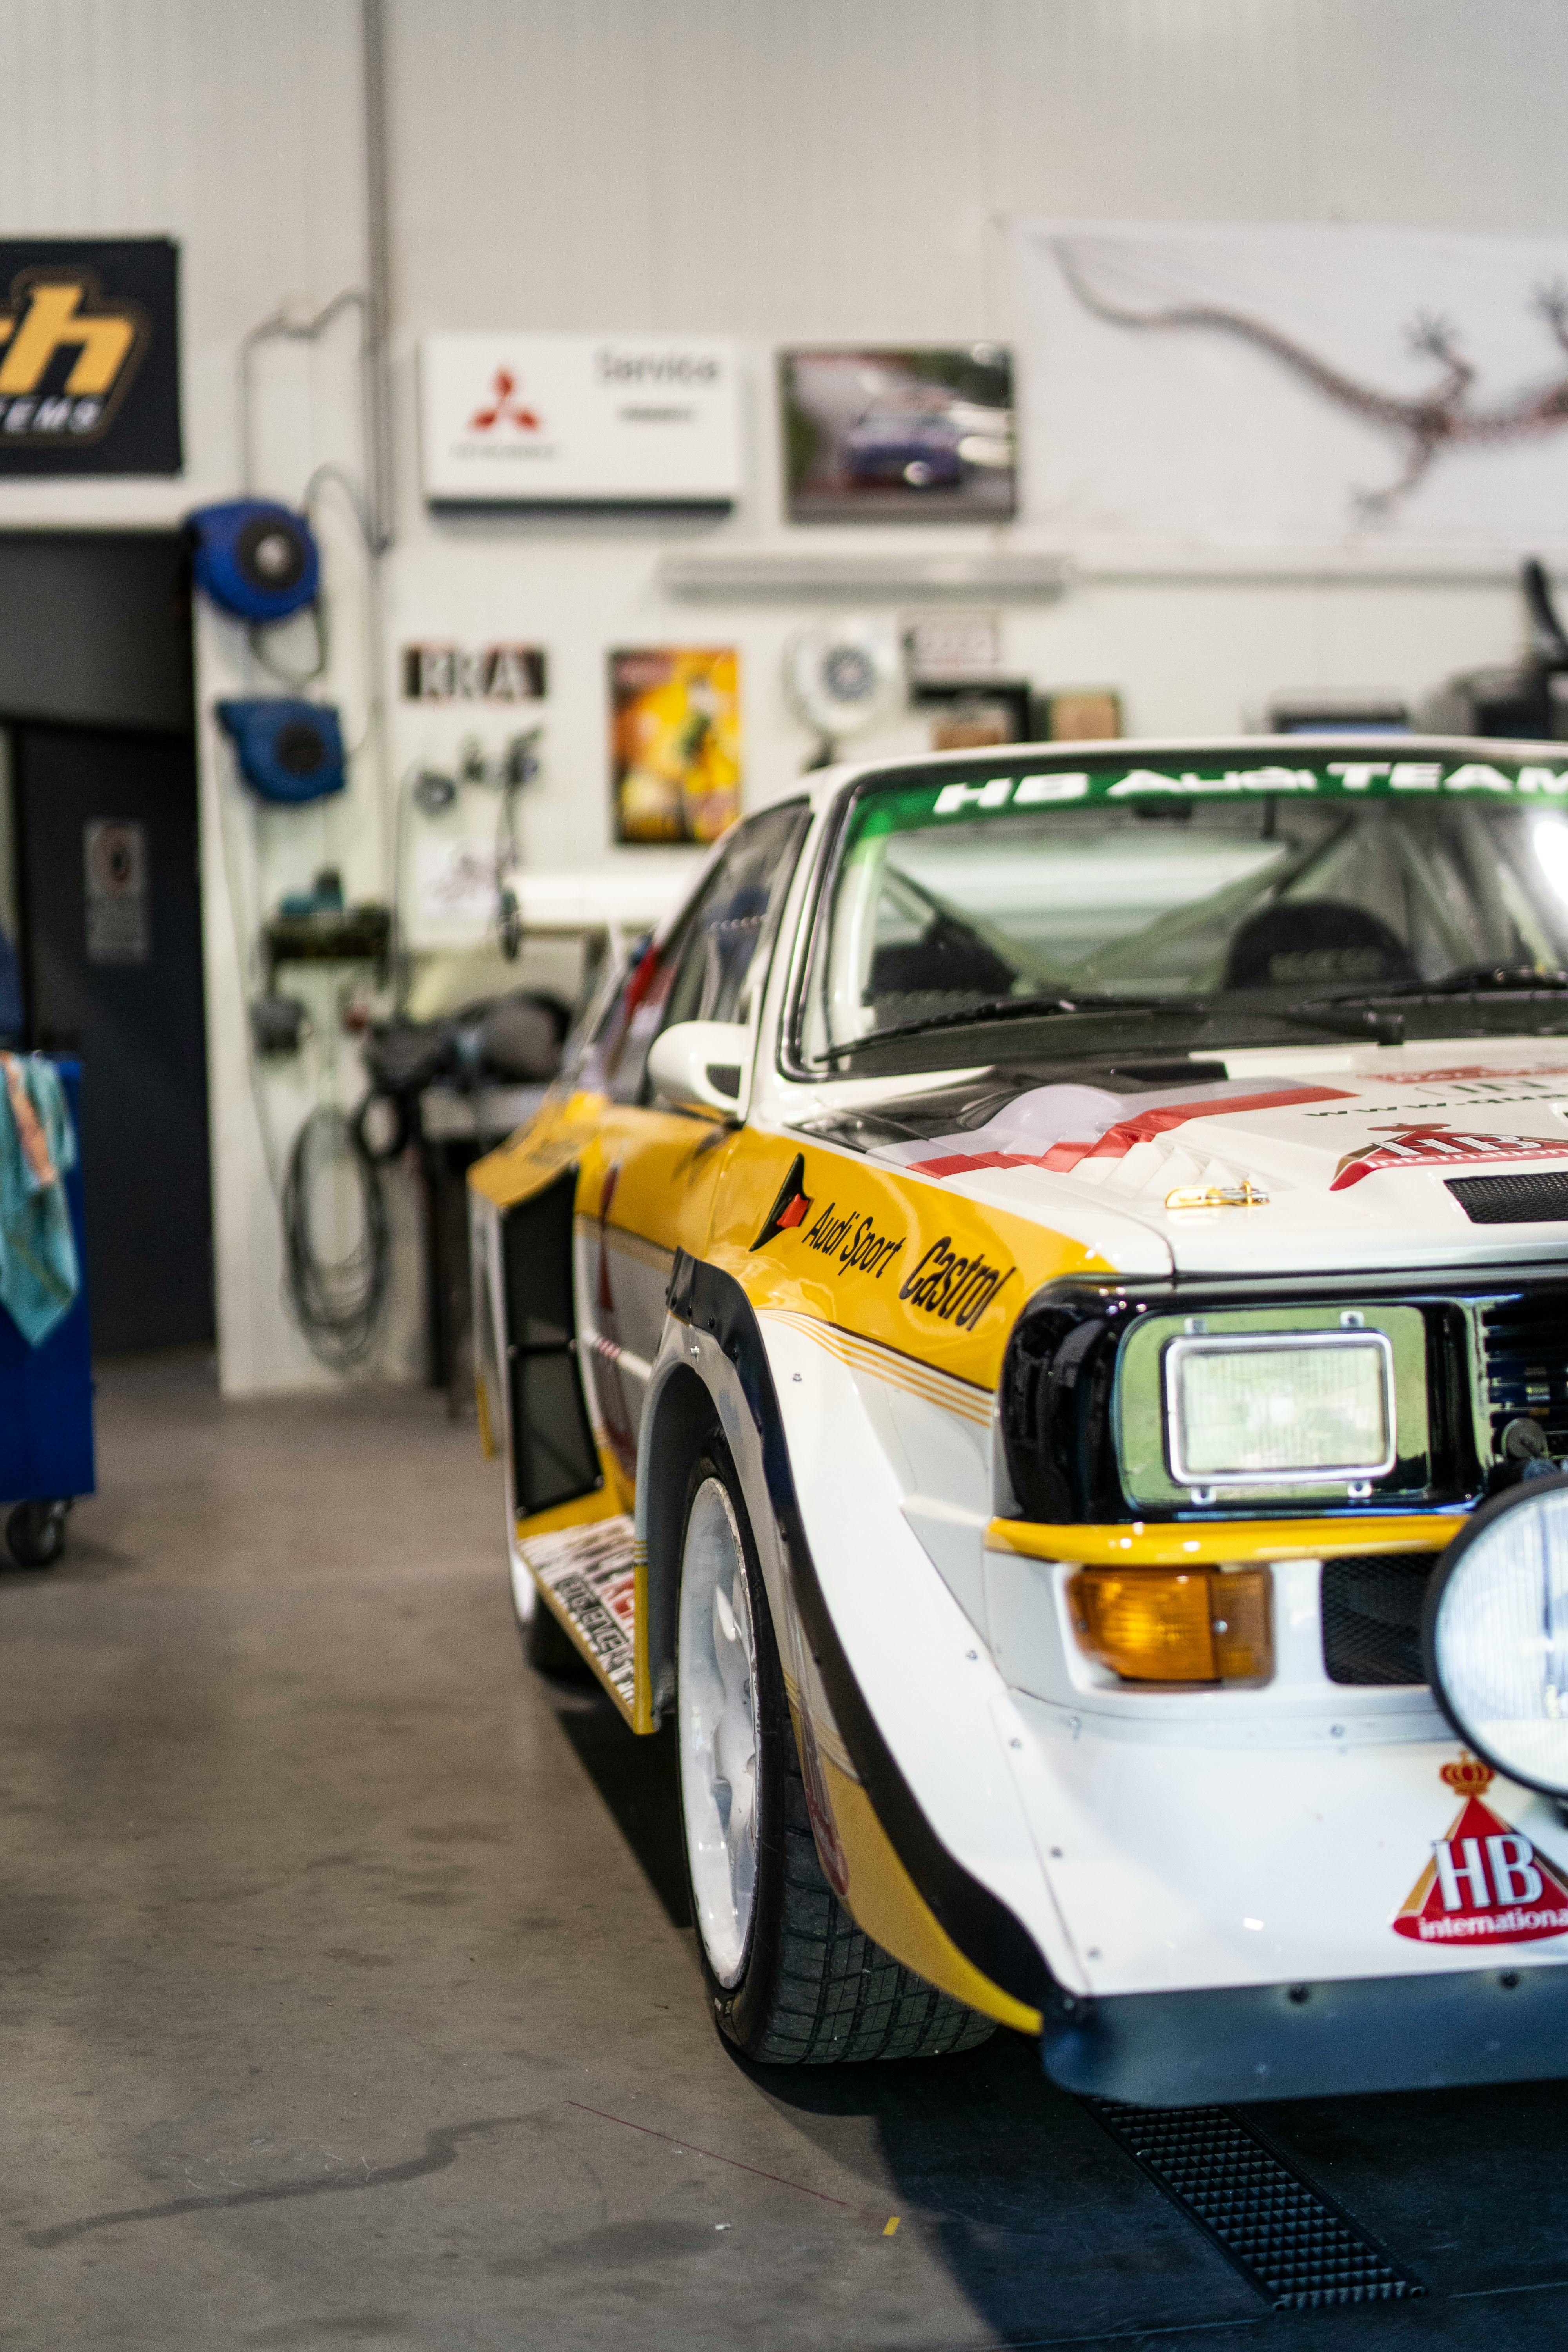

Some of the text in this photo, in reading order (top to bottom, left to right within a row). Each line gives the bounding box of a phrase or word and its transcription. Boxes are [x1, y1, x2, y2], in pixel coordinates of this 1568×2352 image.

[0, 395, 101, 434] EMS
[933, 772, 1089, 814] HB
[1327, 762, 1568, 793] TEAM
[1365, 1135, 1543, 1156] HB
[802, 1202, 906, 1278] Audi Sport
[898, 1236, 1017, 1332] Castrol
[1432, 1834, 1543, 1911] HB
